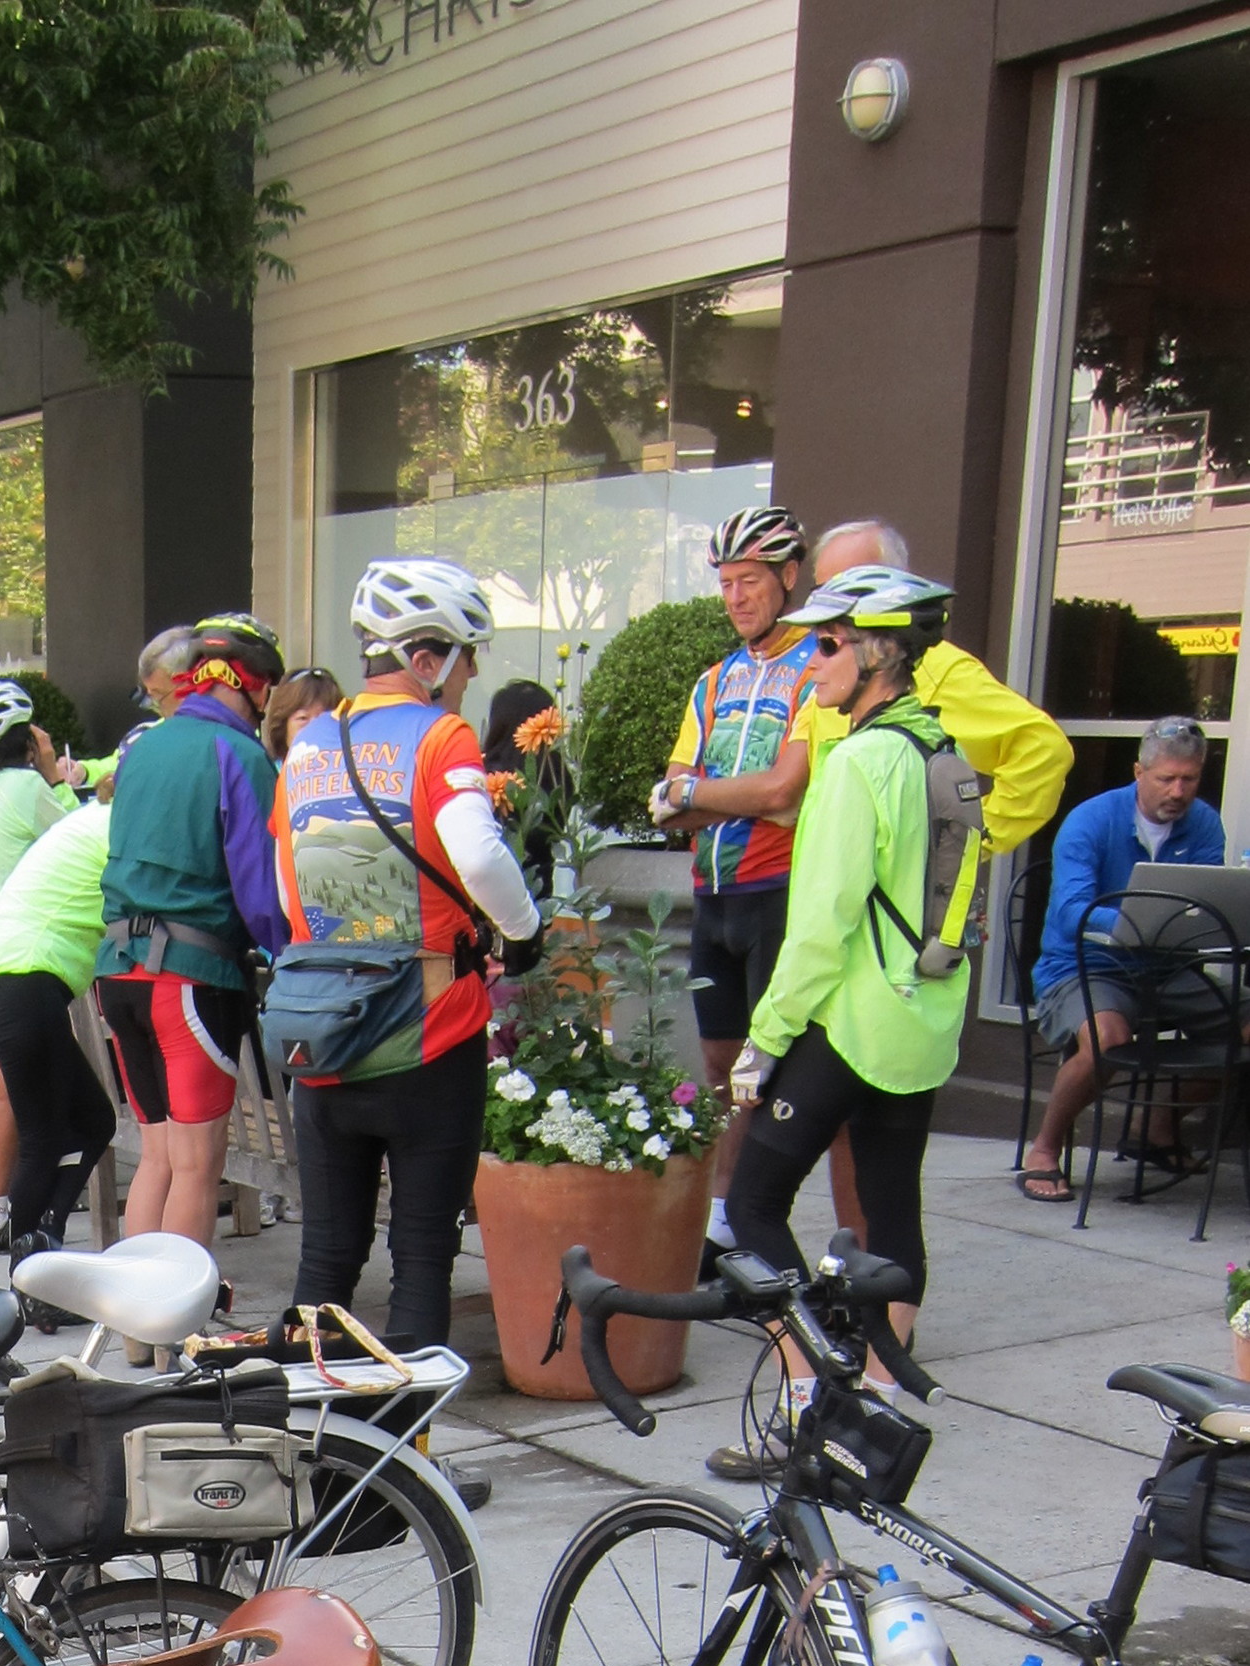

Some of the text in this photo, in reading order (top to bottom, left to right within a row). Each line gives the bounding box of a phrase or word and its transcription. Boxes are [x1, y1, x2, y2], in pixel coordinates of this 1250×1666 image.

[514, 366, 576, 433] 363
[200, 1487, 240, 1501] Trans It
[859, 1501, 956, 1569] S-WORKS
